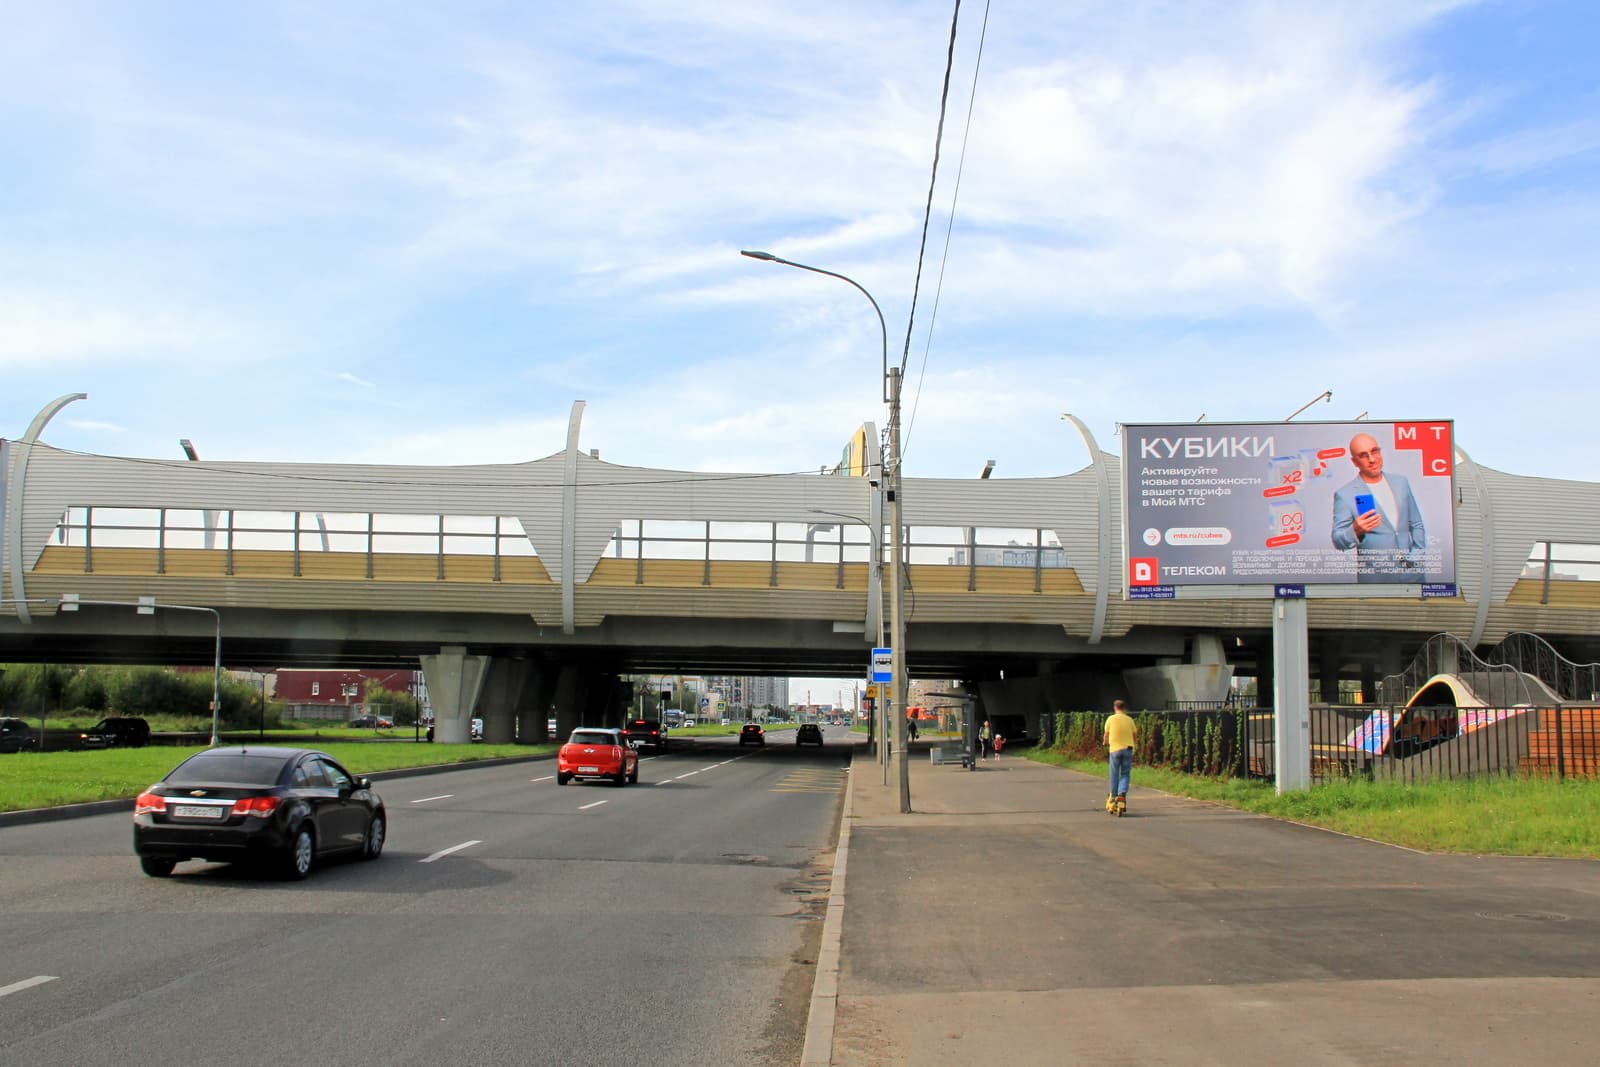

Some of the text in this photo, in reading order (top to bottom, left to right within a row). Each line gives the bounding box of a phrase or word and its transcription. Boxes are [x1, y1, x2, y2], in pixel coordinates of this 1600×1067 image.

[1140, 435, 1275, 460] КУБИКИ
[1140, 466, 1218, 478] Активируйте
[1141, 477, 1261, 487] новые возможности
[1141, 487, 1232, 498] вашего тарифа
[1142, 497, 1206, 508] в Мой МТС
[1161, 565, 1227, 577] ТЕЛЕКОМ
